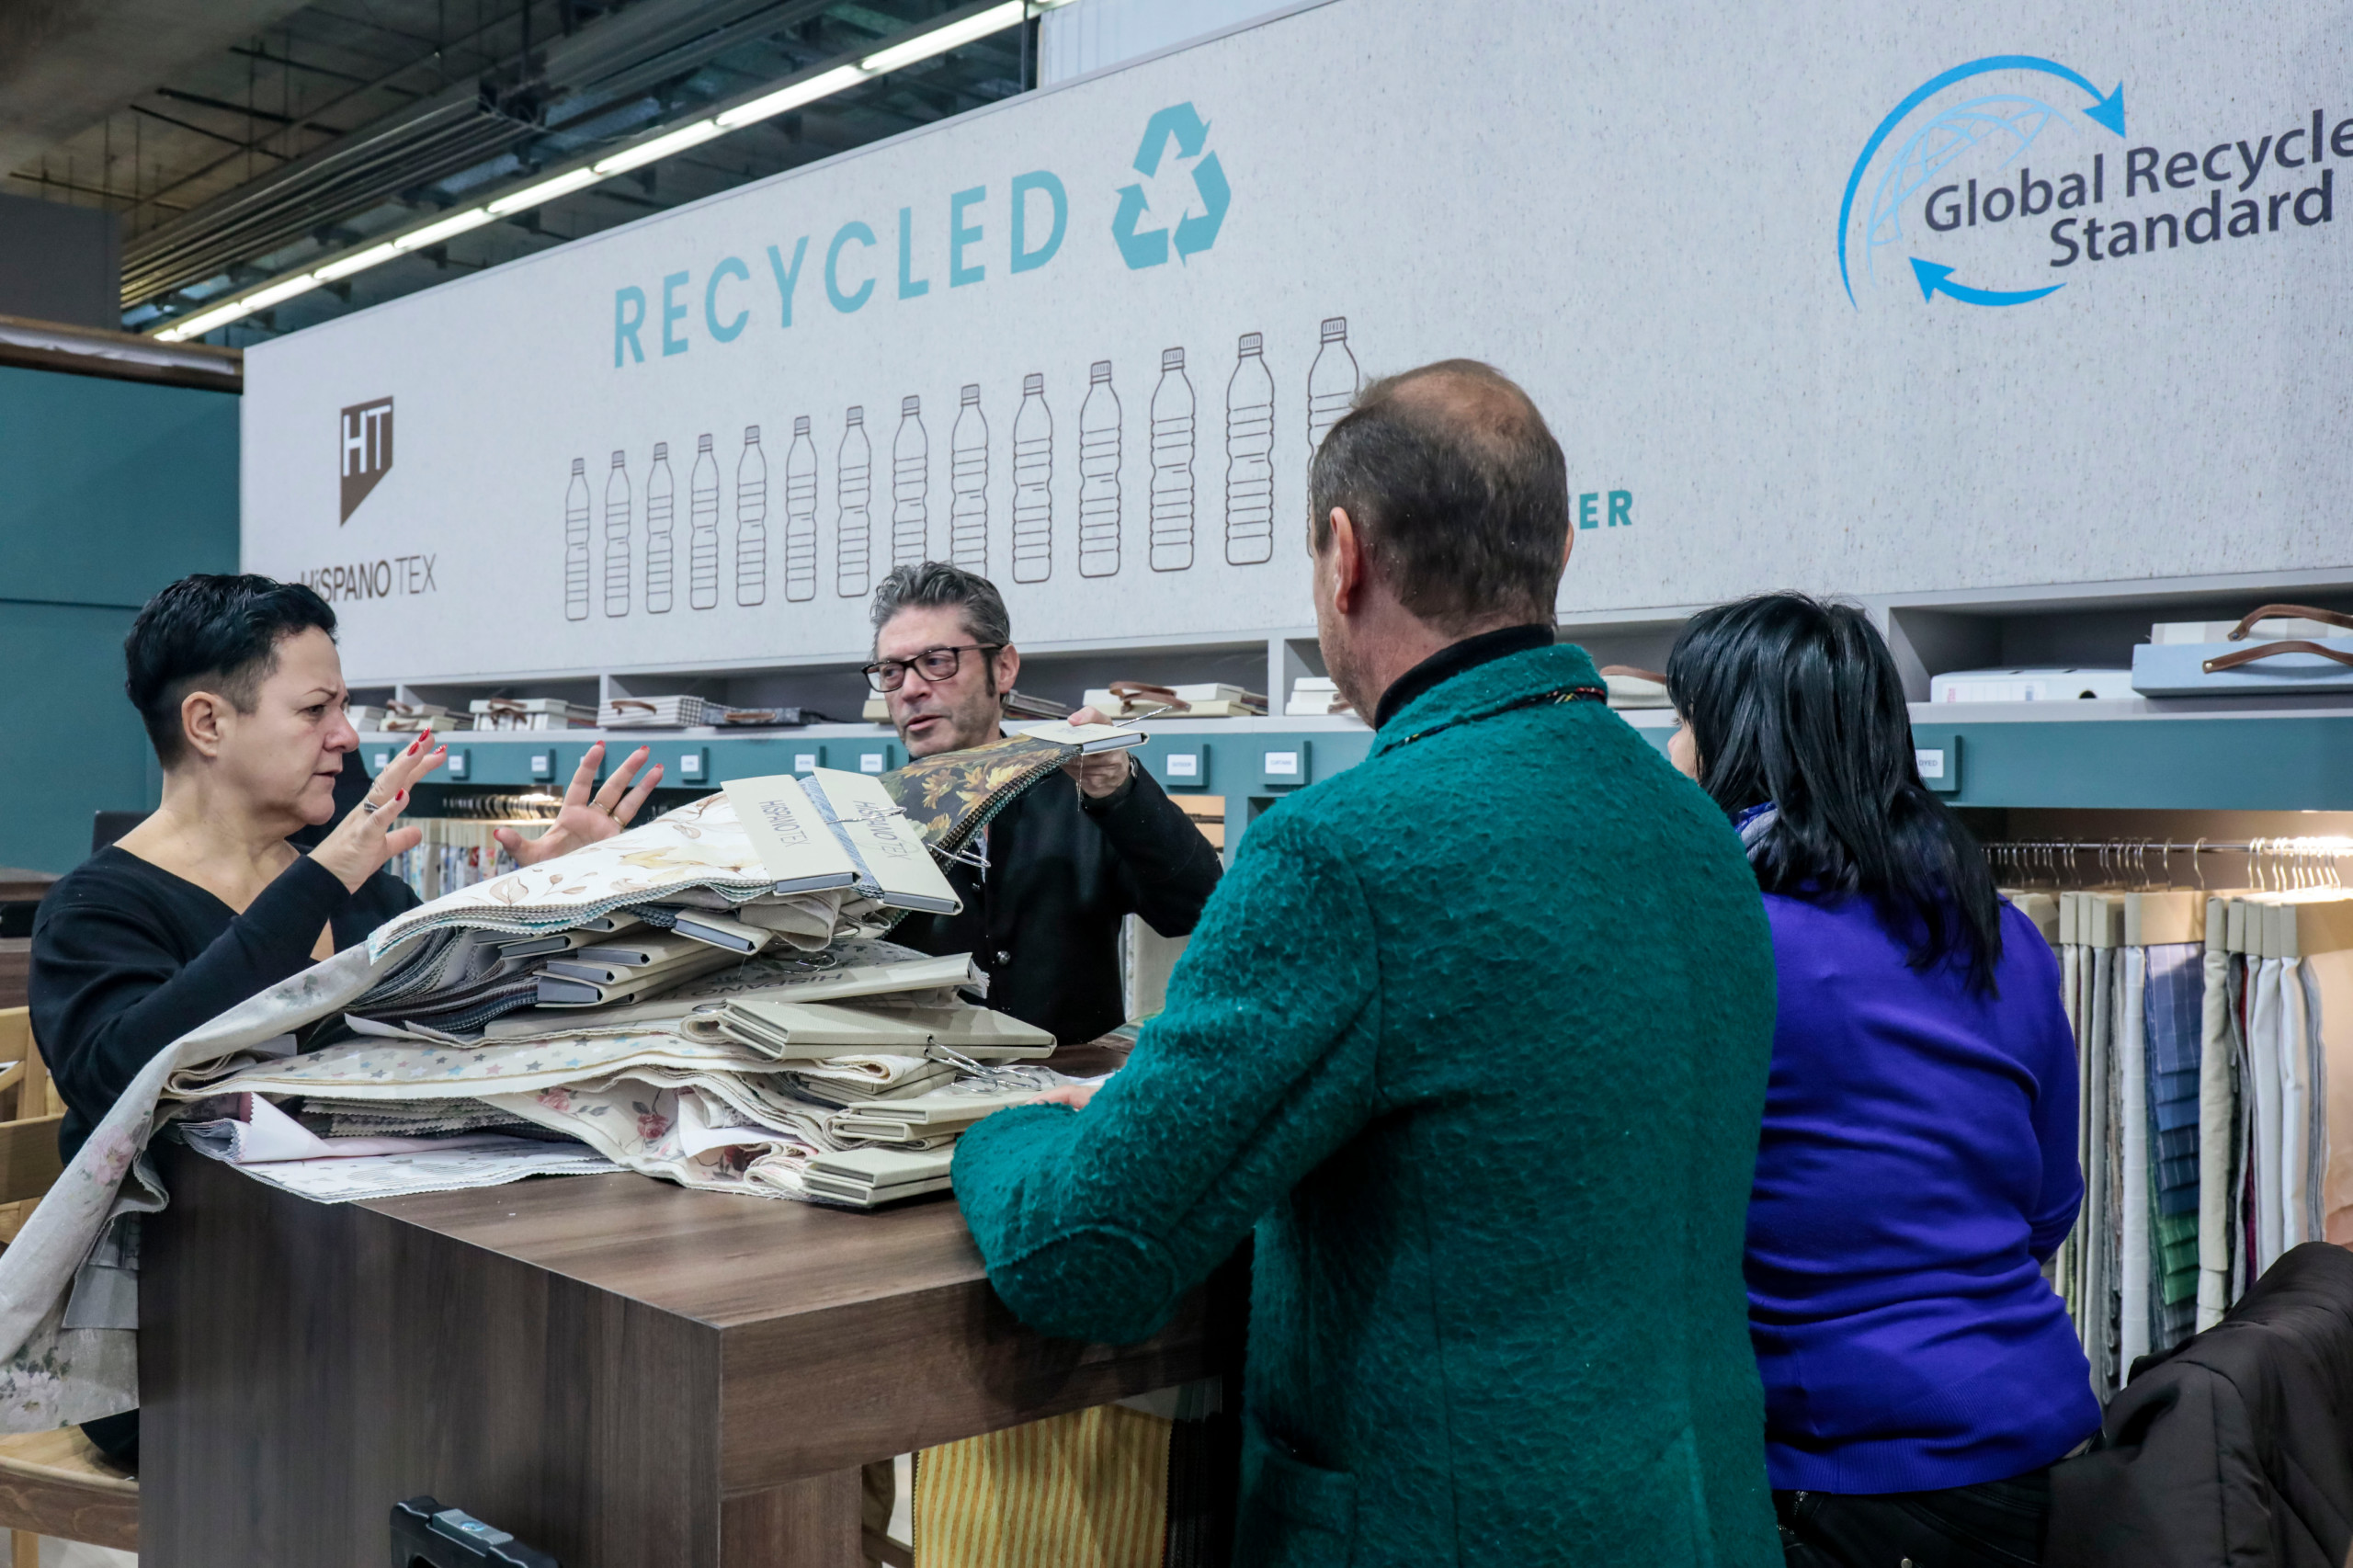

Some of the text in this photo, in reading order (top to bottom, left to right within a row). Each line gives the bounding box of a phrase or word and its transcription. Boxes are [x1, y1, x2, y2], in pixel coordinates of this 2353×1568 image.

[1925, 153, 2104, 232] Global
[2050, 169, 2335, 267] Standard
[614, 170, 1069, 369] RECYCLED
[343, 404, 392, 477] HT
[1568, 490, 1632, 529] ER
[395, 553, 437, 596] TEX
[1919, 759, 1938, 767] DYED
[780, 830, 811, 847] TEX
[881, 842, 912, 860] TEX
